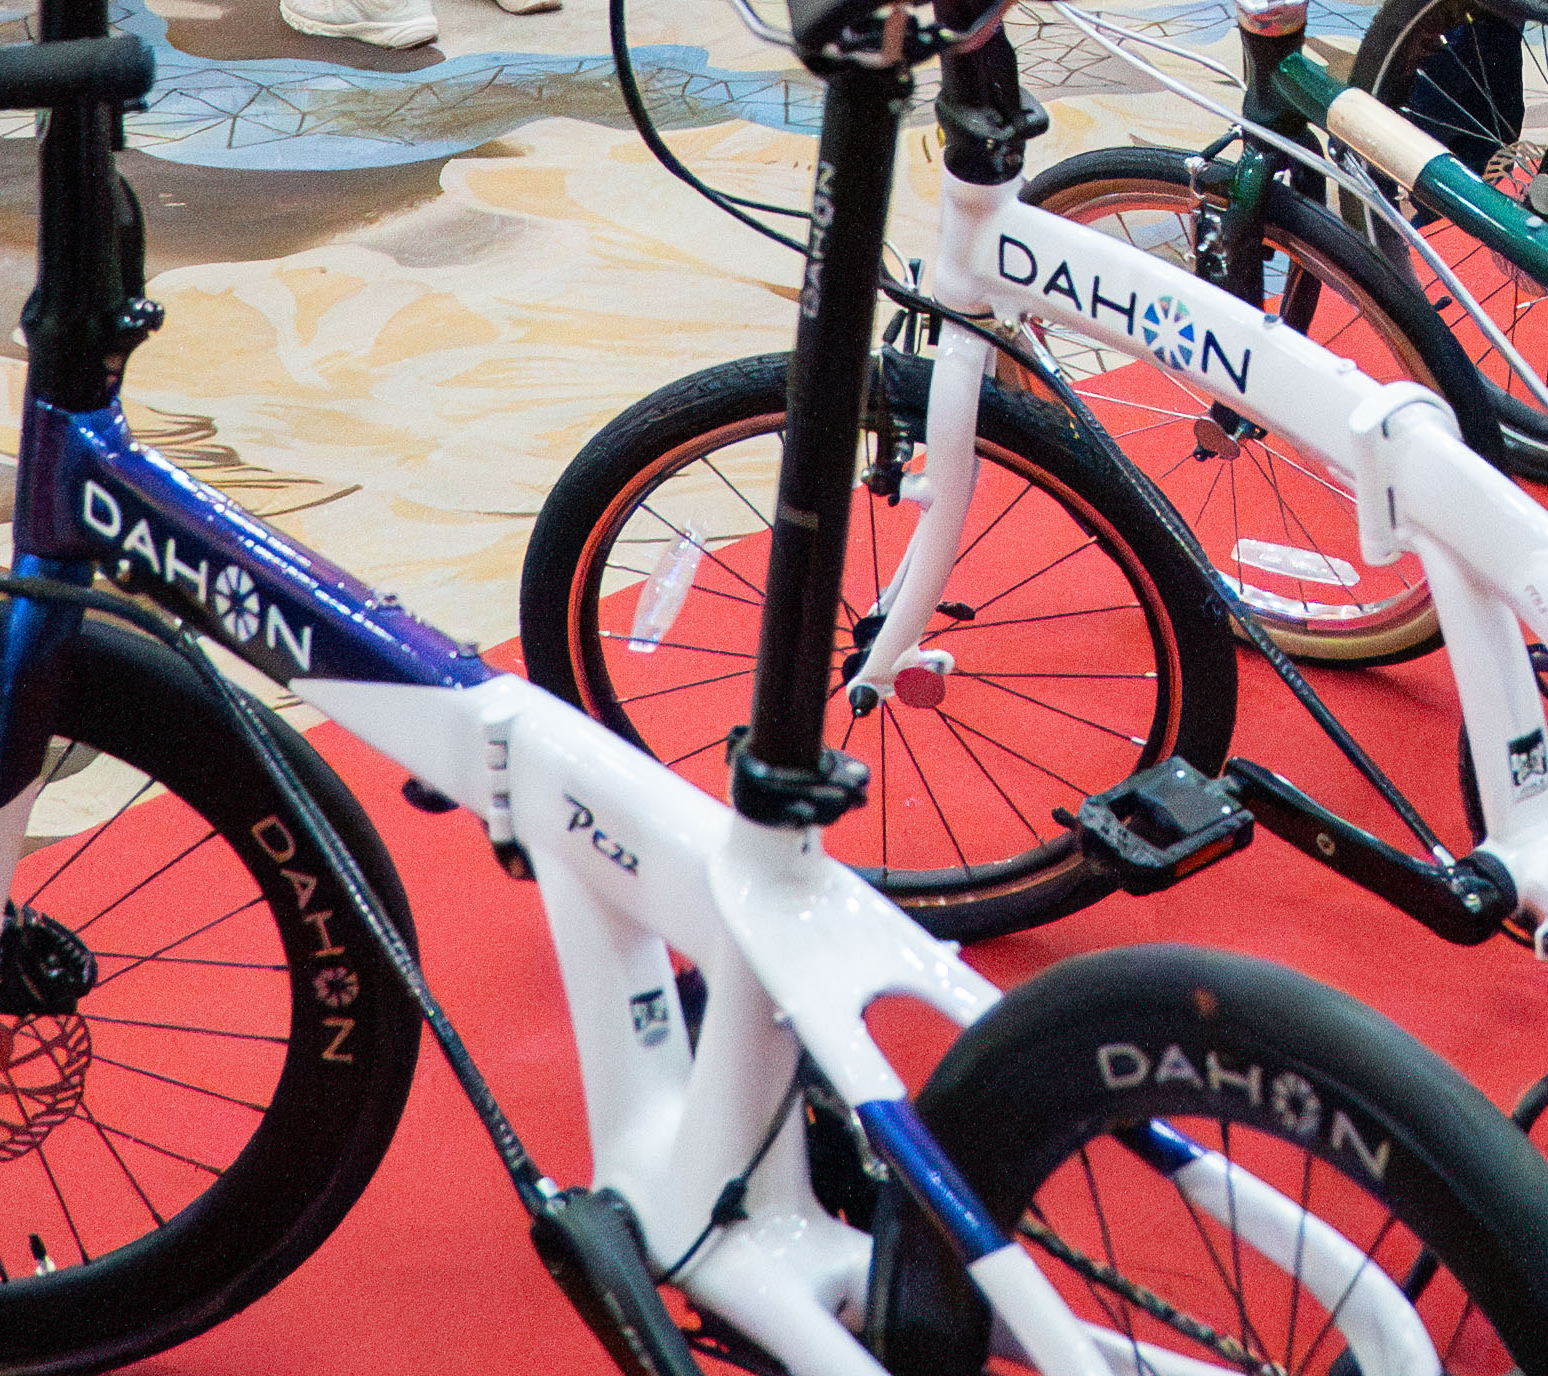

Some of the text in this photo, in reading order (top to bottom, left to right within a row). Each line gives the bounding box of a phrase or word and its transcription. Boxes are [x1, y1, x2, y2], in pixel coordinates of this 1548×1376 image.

[998, 233, 1252, 396] DAHON
[82, 480, 314, 669] DAHON
[249, 813, 360, 1066] DAHON
[1097, 1041, 1391, 1180] DAHON
